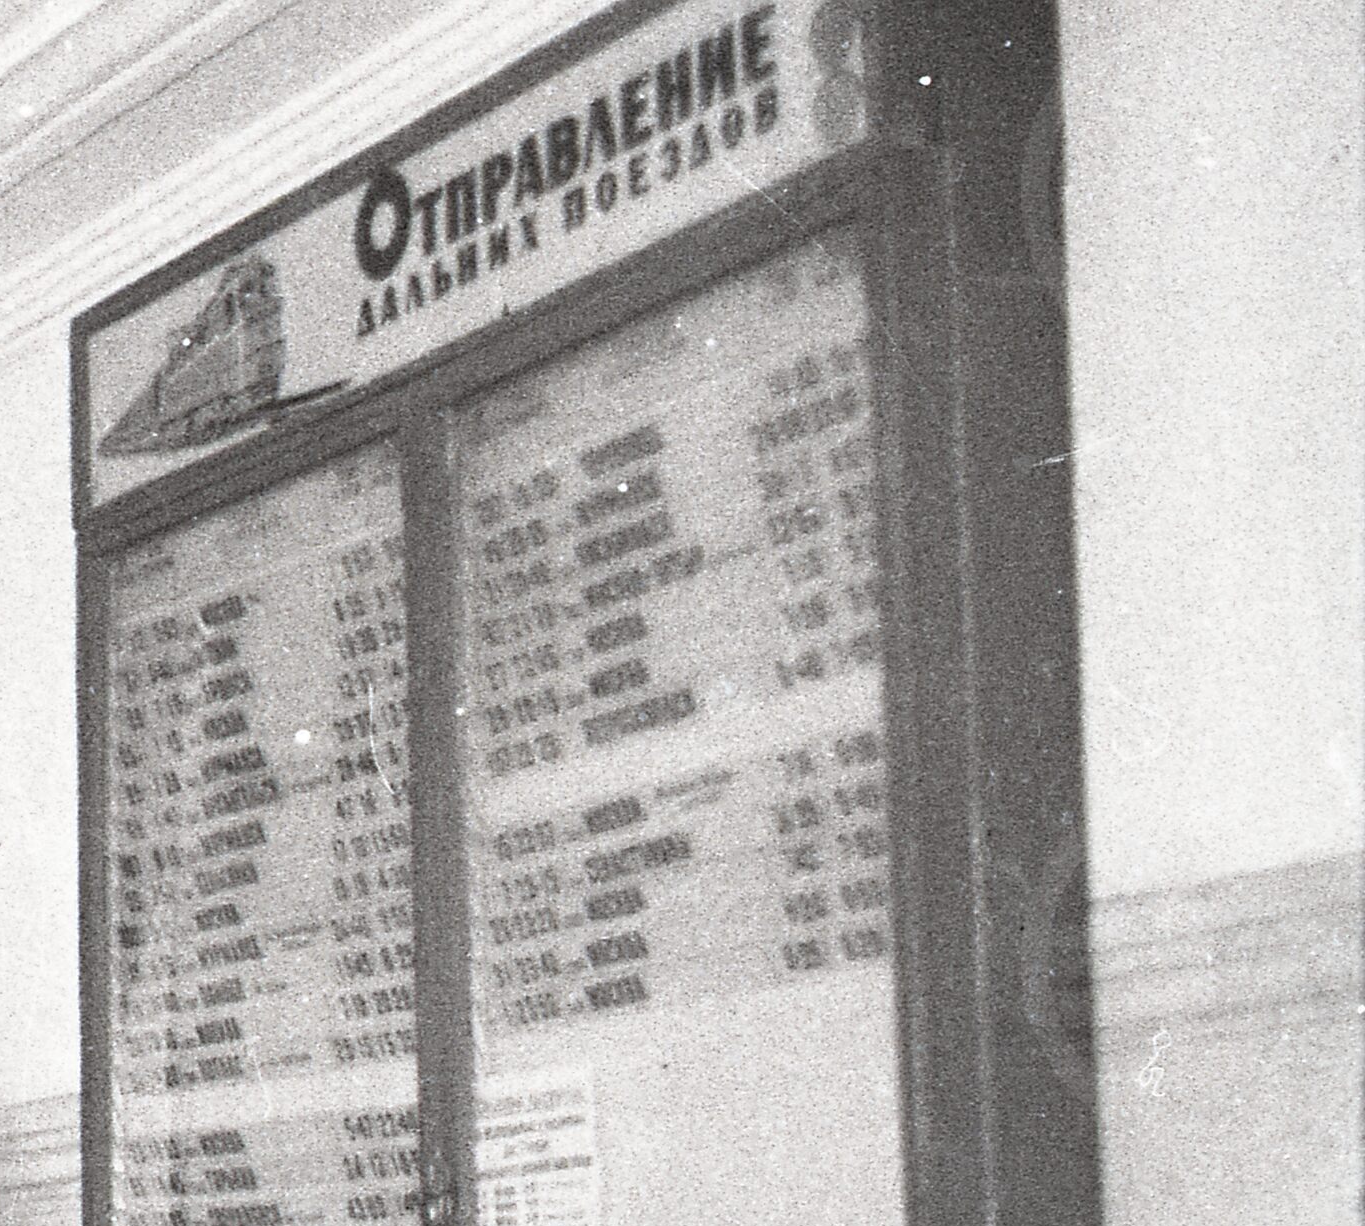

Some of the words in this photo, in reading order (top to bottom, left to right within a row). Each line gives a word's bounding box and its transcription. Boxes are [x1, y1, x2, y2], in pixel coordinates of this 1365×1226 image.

[354, 8, 778, 281] ОТПРАВЛЕНИЕ
[355, 214, 539, 338] ДАЛЬНИХ
[564, 86, 779, 234] ПОЕЗДОВ
